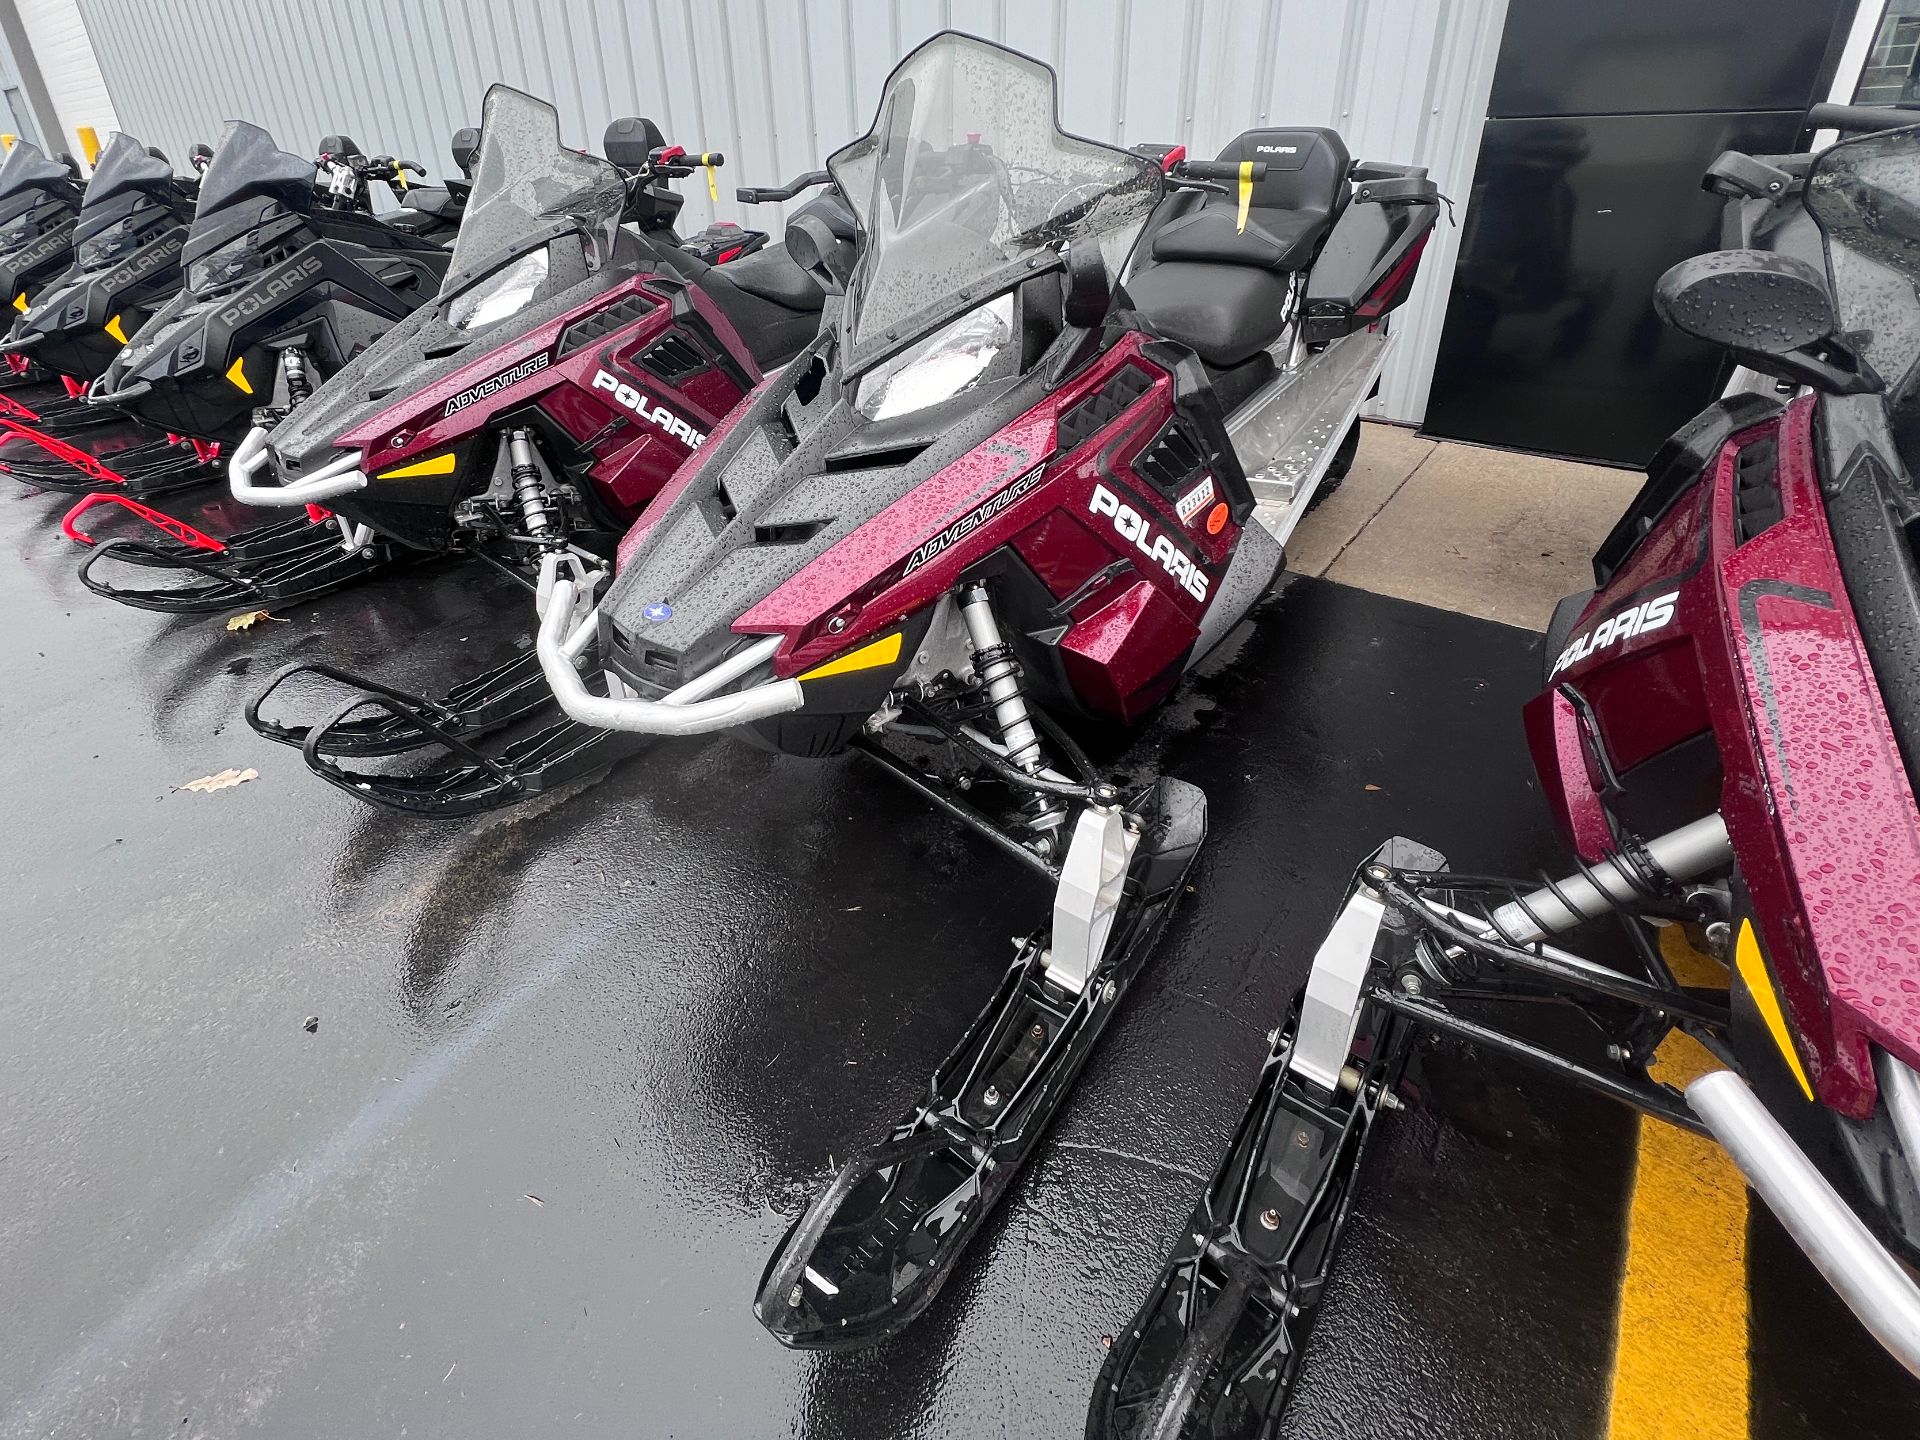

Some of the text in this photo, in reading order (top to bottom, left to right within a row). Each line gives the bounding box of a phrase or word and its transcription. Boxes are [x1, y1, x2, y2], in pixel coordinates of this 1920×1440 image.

[1256, 145, 1297, 154] POLARIS
[6, 228, 72, 273] POLARIS
[100, 238, 183, 293] POLARIS
[220, 256, 323, 327] POLARIS
[444, 351, 549, 417] ADVENTURE
[902, 462, 1046, 577] ADVENTURE
[1088, 483, 1210, 603] POLARIS
[1547, 590, 1680, 683] POLARIS
